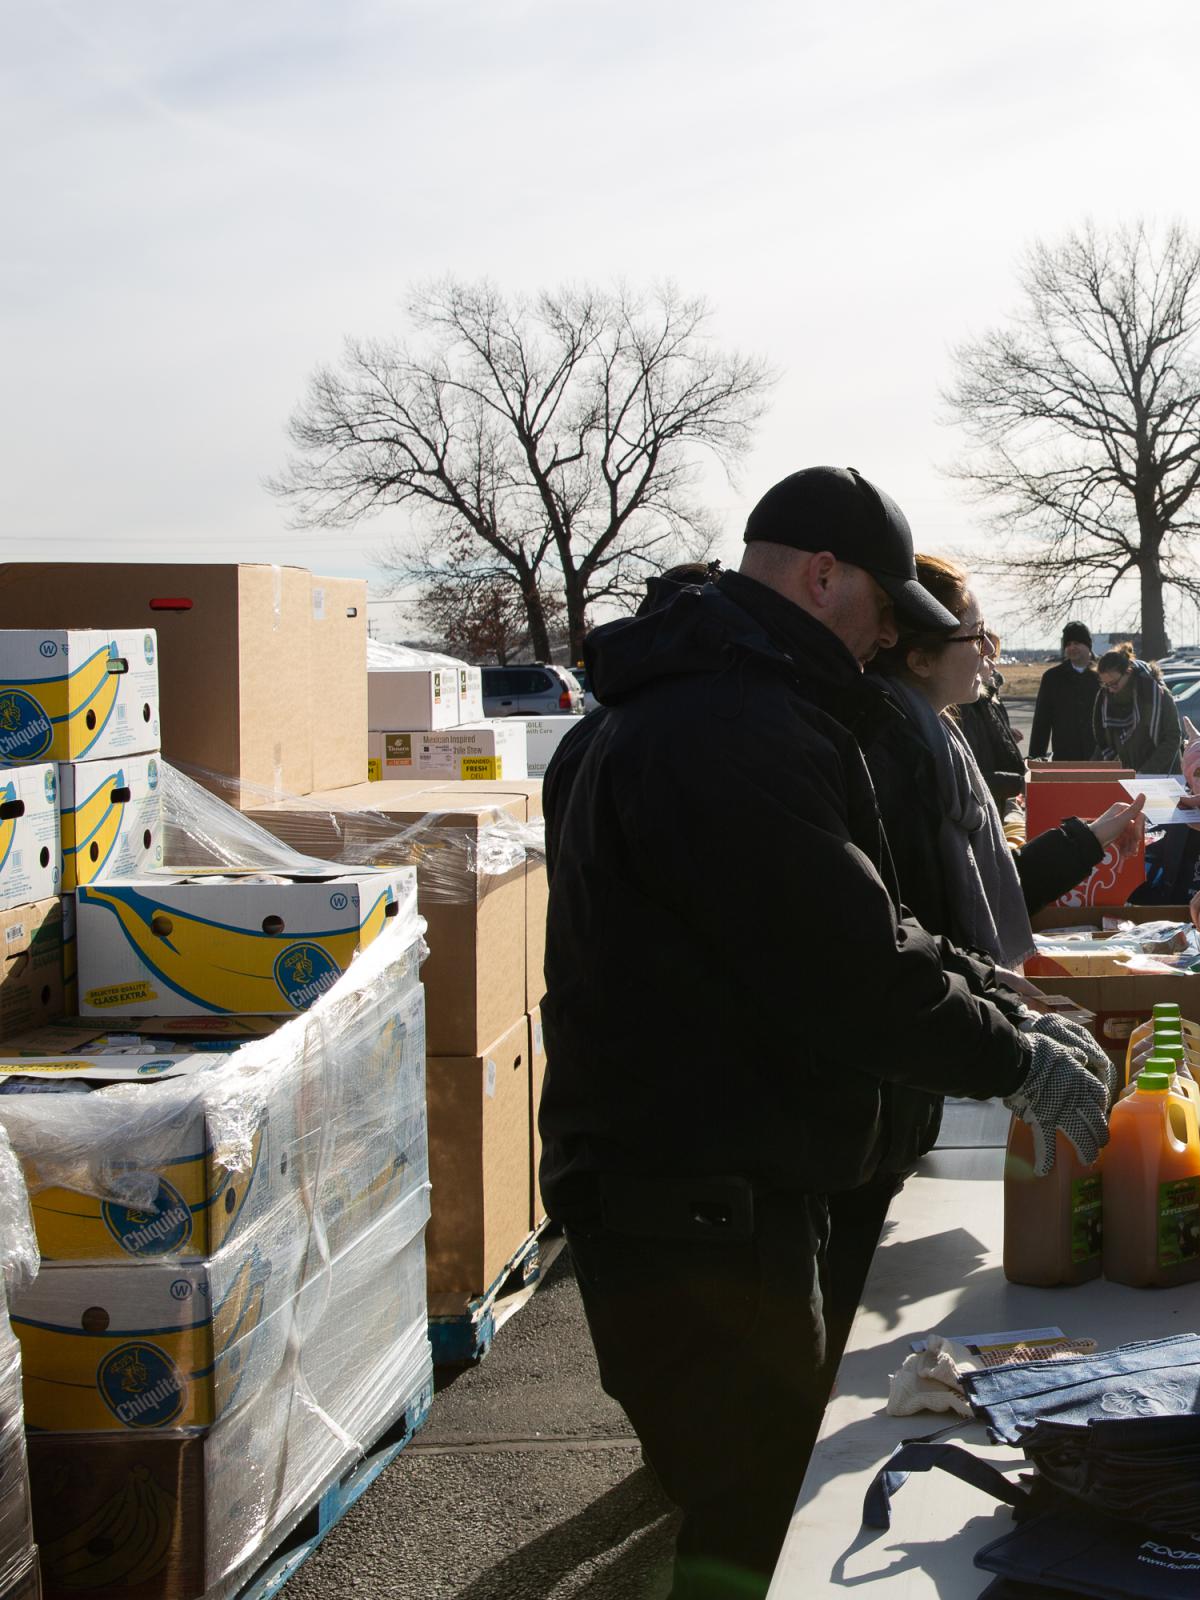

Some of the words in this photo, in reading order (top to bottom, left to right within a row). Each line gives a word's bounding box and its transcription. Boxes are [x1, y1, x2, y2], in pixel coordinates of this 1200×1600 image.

[0, 715, 50, 754] Chiquita
[423, 735, 450, 743] Mexican
[450, 734, 476, 745] Inspired
[94, 995, 119, 1005] CLASS
[120, 990, 147, 1001] EXTRA
[288, 966, 341, 1008] Chiquita
[121, 1205, 189, 1252] Chiquita
[115, 1374, 183, 1423] Chiquita
